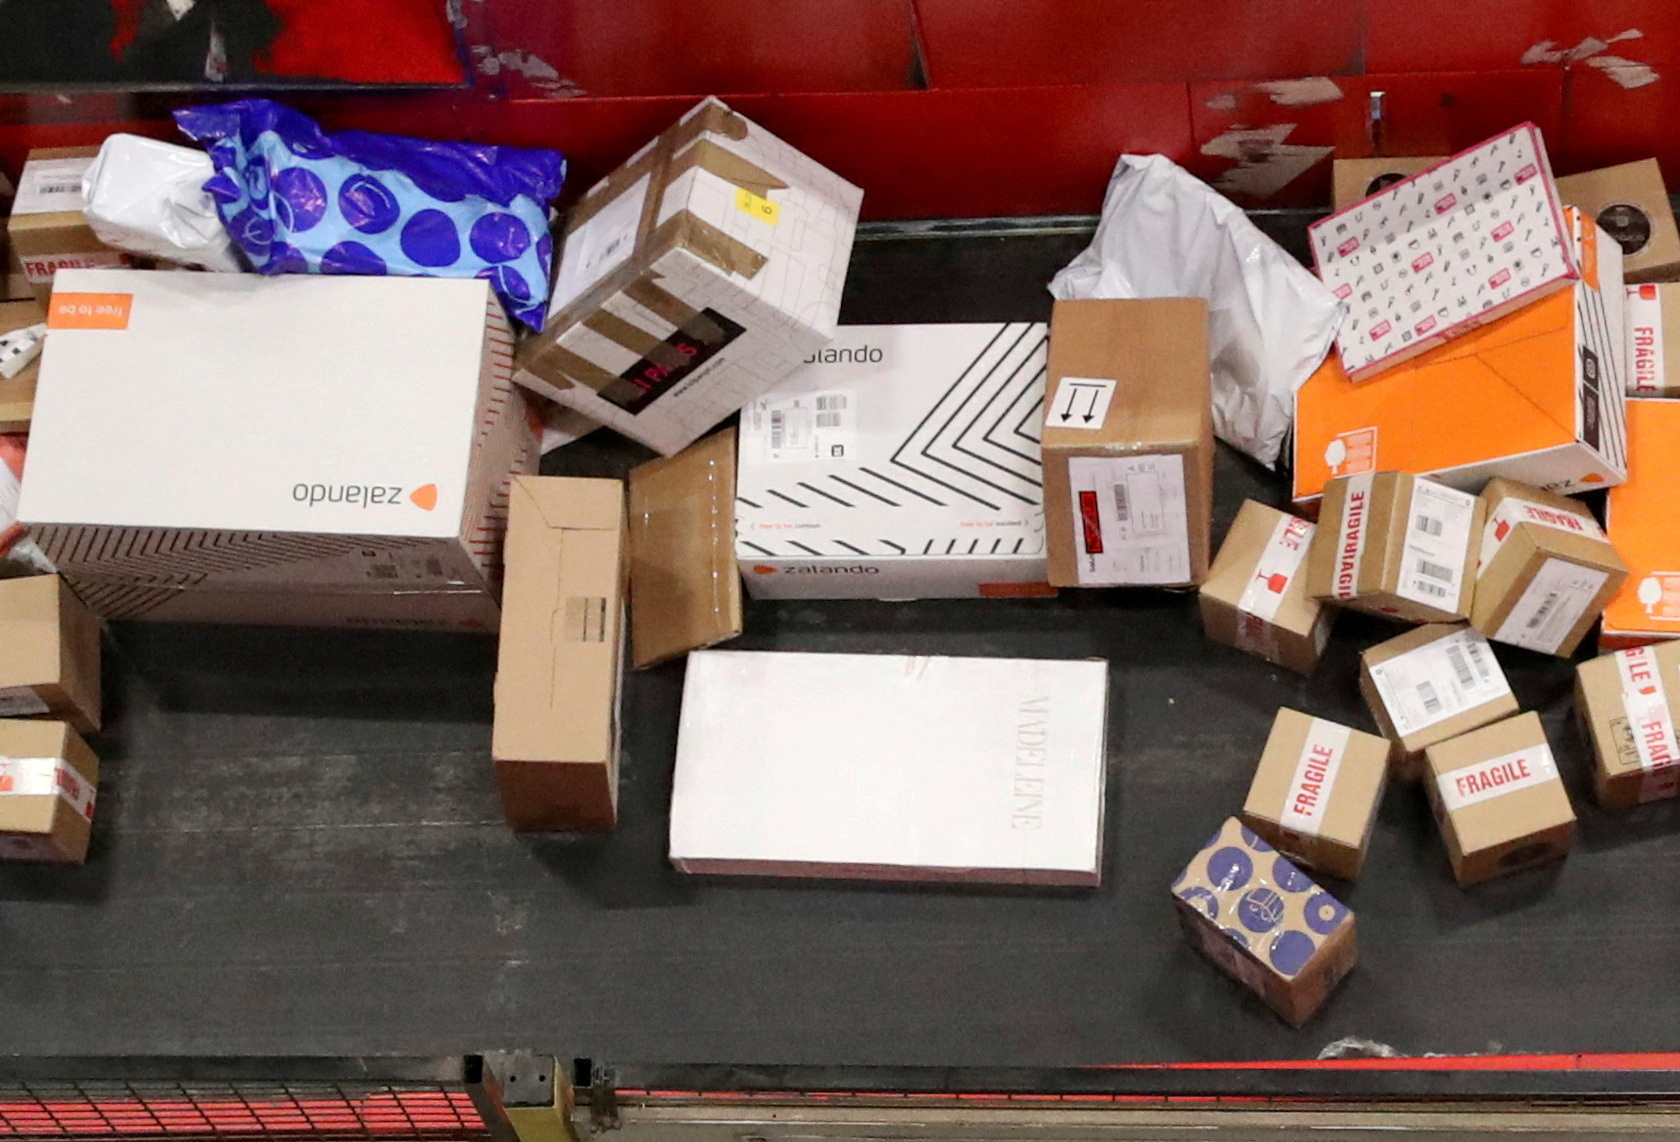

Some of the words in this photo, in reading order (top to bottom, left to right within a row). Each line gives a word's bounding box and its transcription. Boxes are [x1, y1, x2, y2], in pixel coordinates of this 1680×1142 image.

[293, 483, 403, 508] zalando
[1523, 505, 1584, 531] FRAGILE
[783, 564, 880, 576] zalando
[1011, 695, 1050, 829] MADELEINE
[1455, 758, 1531, 797] FRAGILE
[1293, 744, 1333, 817] FRAGILE
